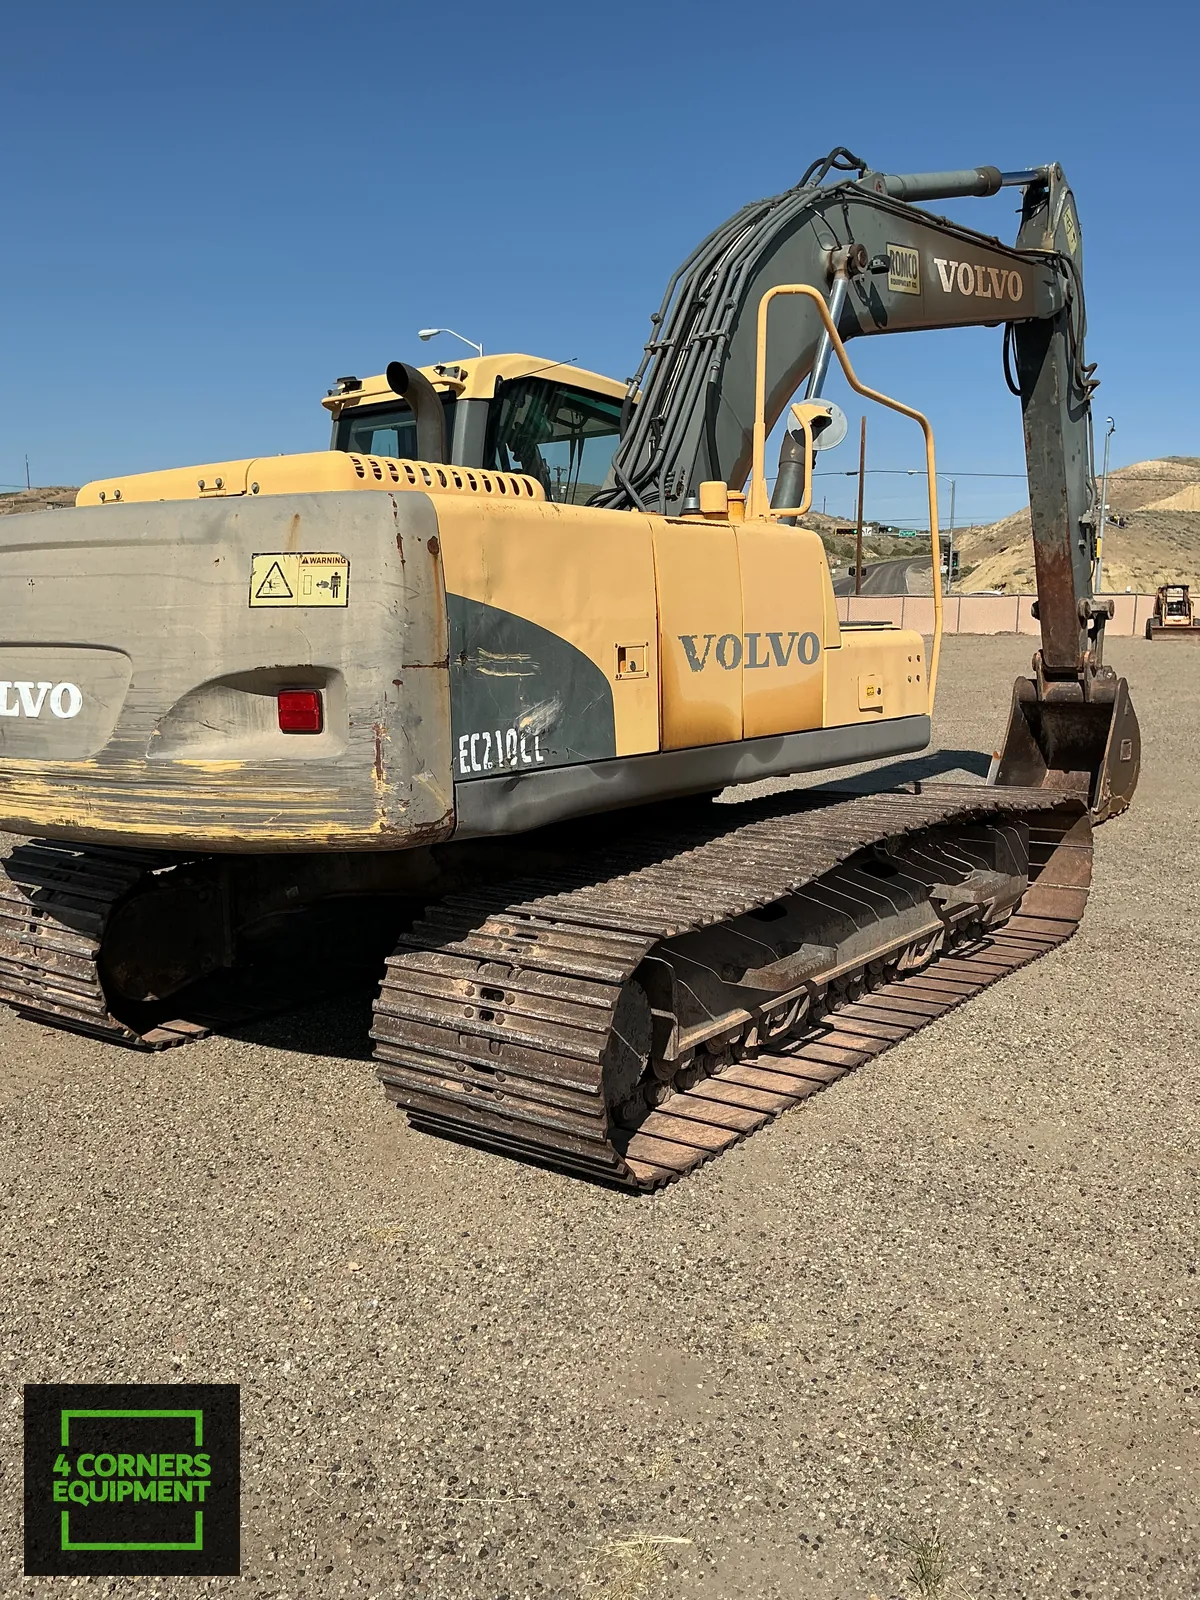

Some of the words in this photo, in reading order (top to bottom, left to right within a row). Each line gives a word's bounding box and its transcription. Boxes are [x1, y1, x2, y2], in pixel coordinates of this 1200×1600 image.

[889, 249, 918, 280] ROMCO
[934, 258, 1023, 301] VOLVO
[677, 631, 820, 672] VOLVO
